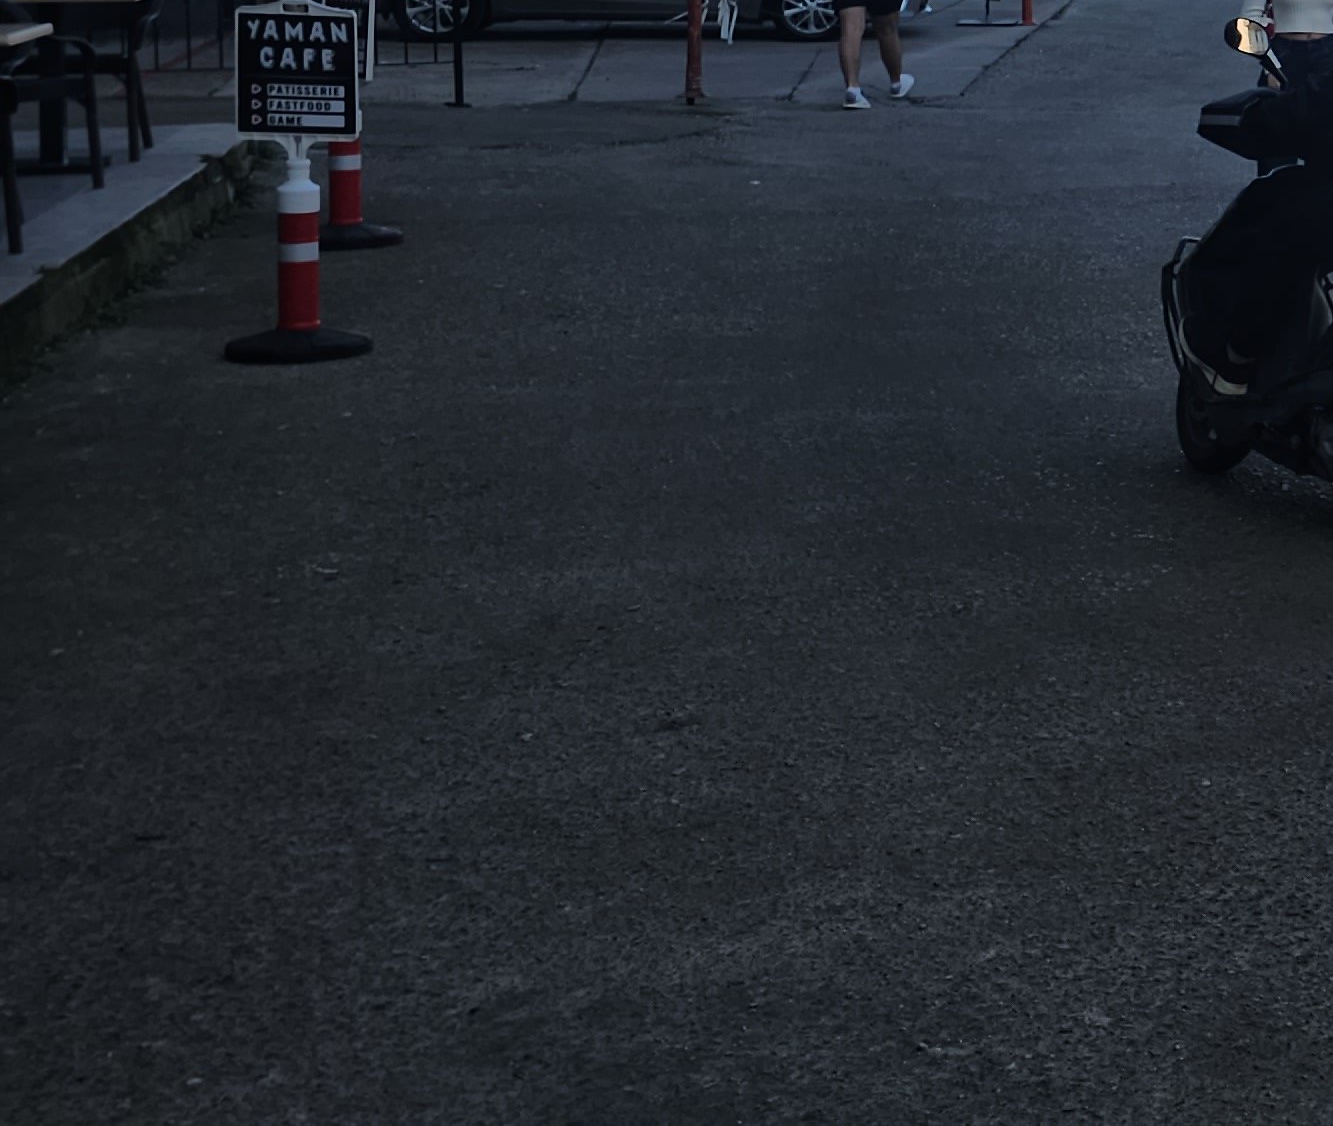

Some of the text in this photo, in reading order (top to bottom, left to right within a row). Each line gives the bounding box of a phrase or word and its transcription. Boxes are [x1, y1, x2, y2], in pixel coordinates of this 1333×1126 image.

[247, 18, 349, 43] YAMAN
[259, 45, 336, 72] CAFE
[269, 85, 340, 96] PATISSERIE
[269, 101, 331, 112] FASTFOOD
[269, 116, 303, 125] GAME
